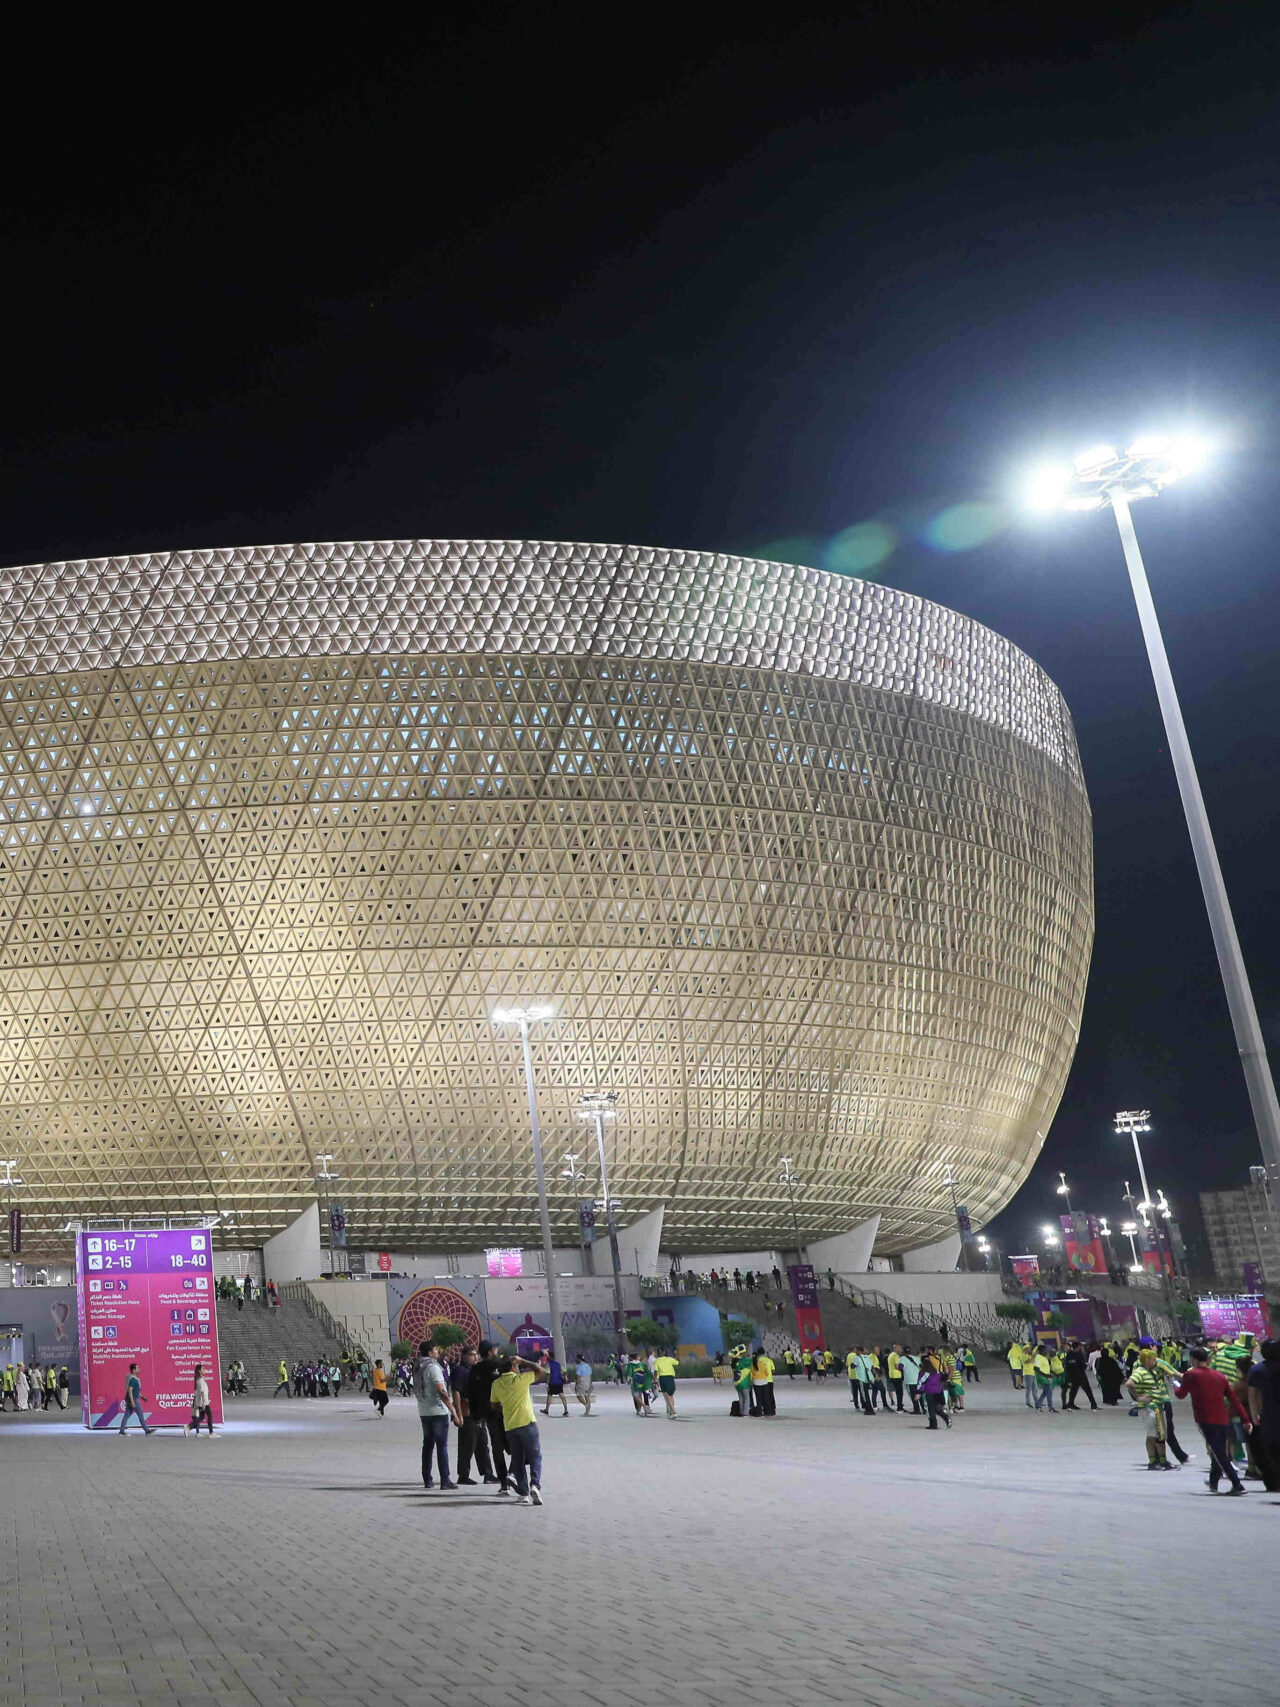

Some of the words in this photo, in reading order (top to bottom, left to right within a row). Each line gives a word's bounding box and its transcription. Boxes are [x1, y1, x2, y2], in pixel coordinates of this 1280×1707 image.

[104, 1239, 136, 1252] 16-17
[105, 1256, 132, 1269] 2-15
[170, 1254, 207, 1268] 18-40
